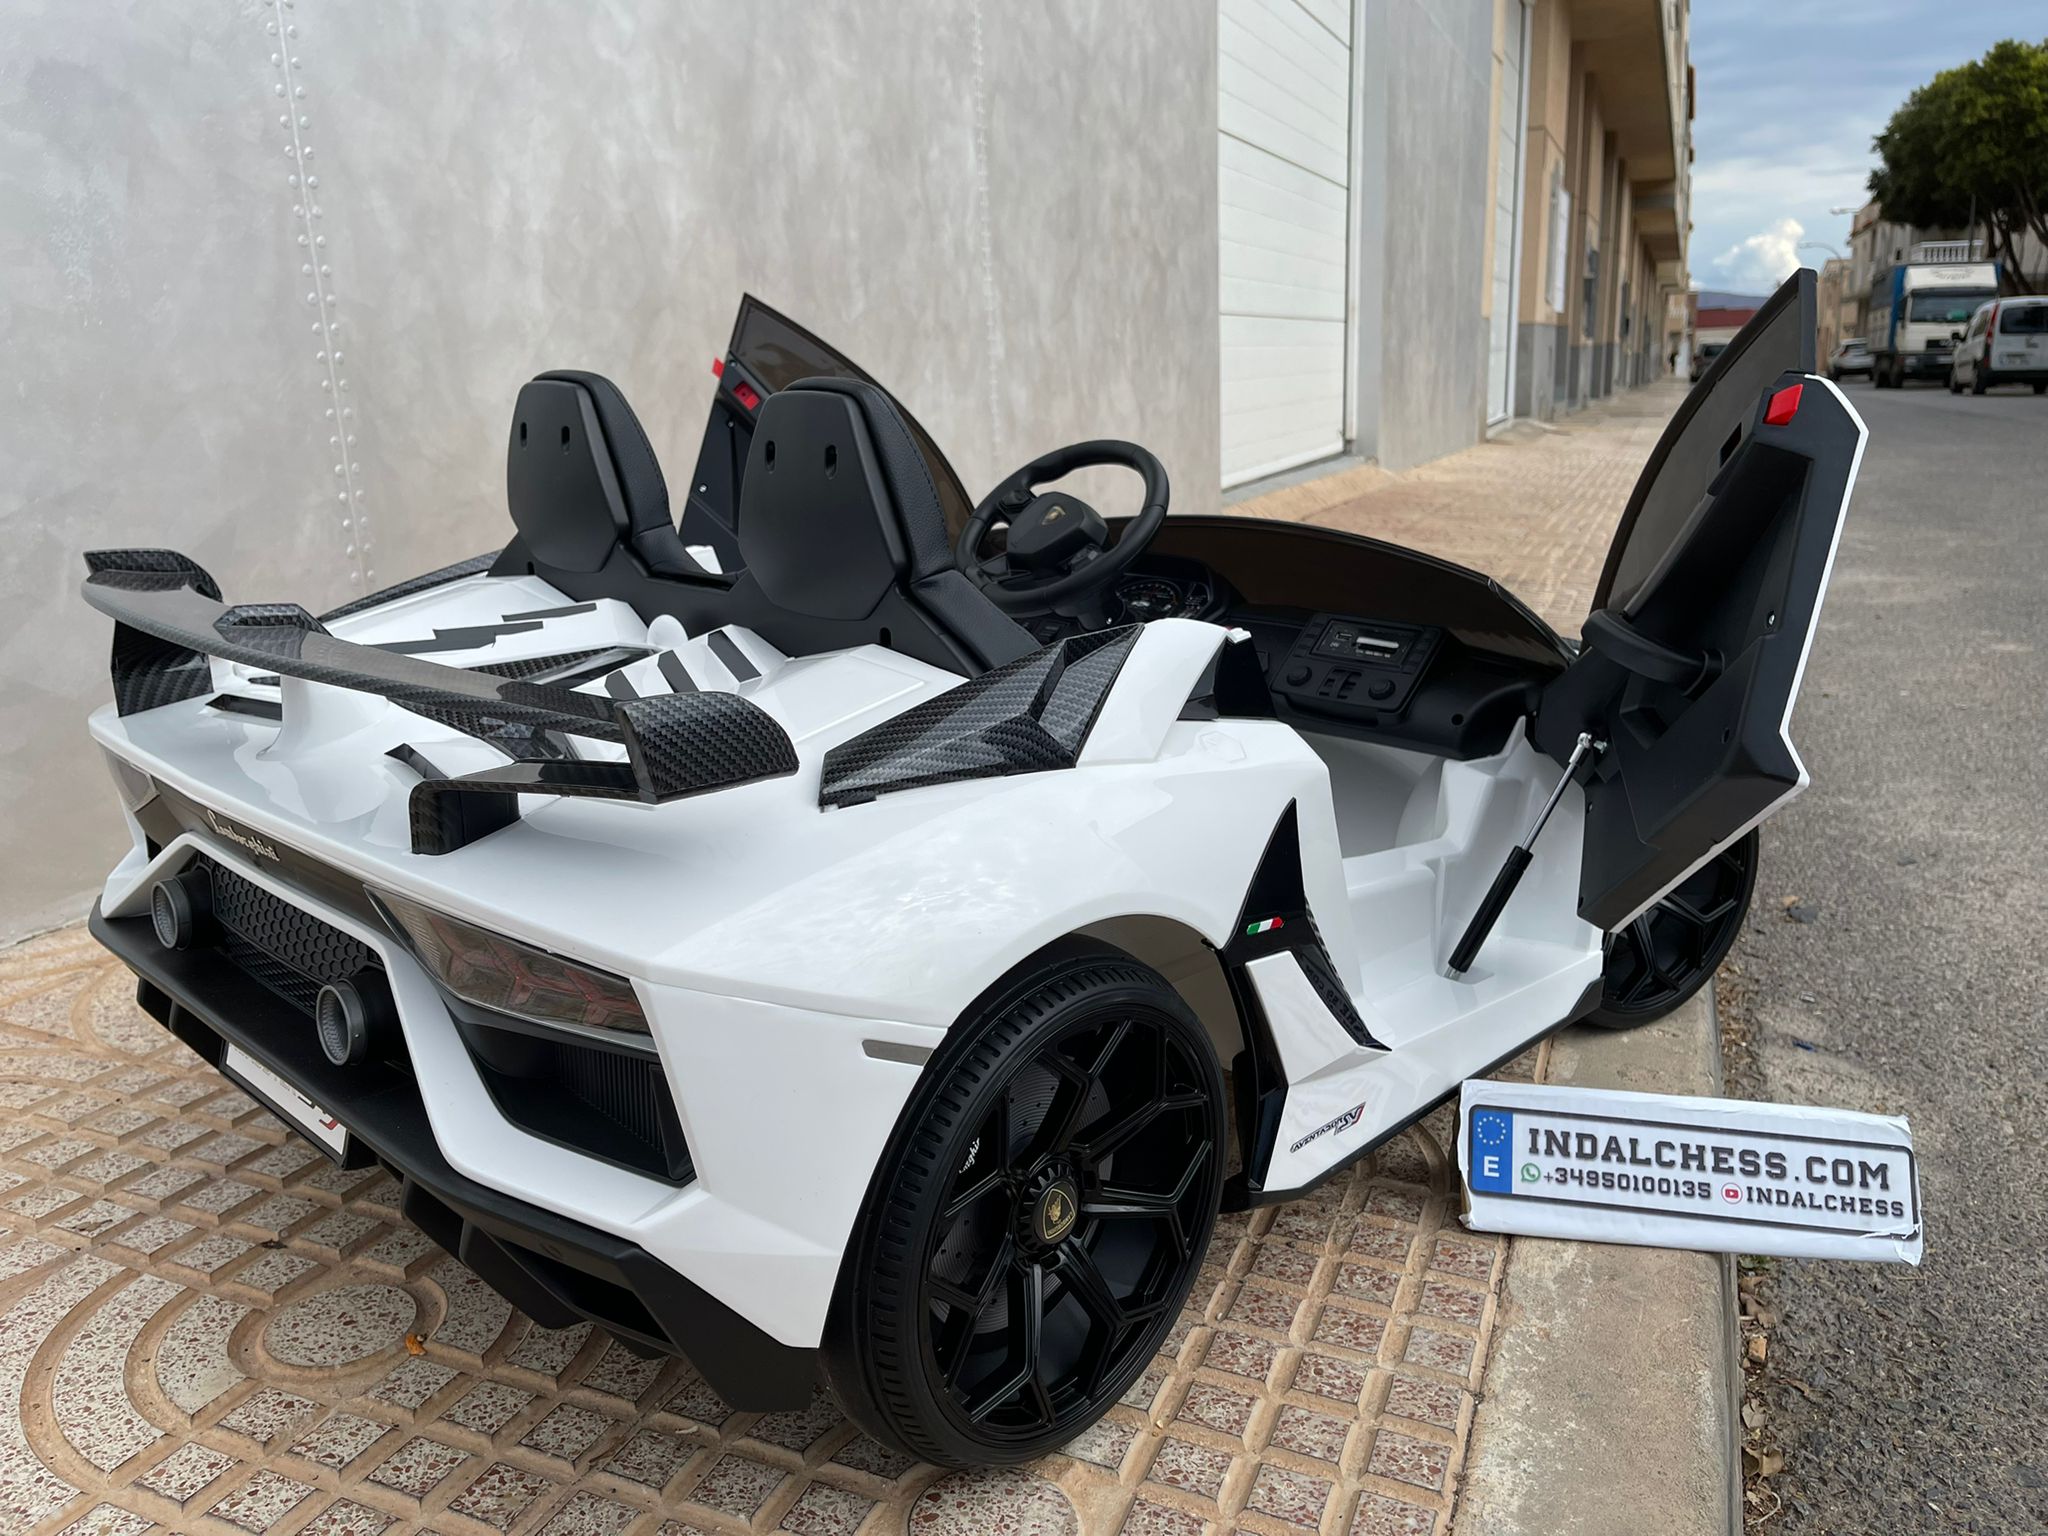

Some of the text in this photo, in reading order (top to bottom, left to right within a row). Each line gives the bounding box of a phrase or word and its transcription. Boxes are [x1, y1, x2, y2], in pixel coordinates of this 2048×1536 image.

[1483, 1155, 1500, 1178] E
[1528, 1128, 1890, 1191] INDALCHESS.COM
[1543, 1166, 1905, 1218] +34950100135 INDALCHESS
